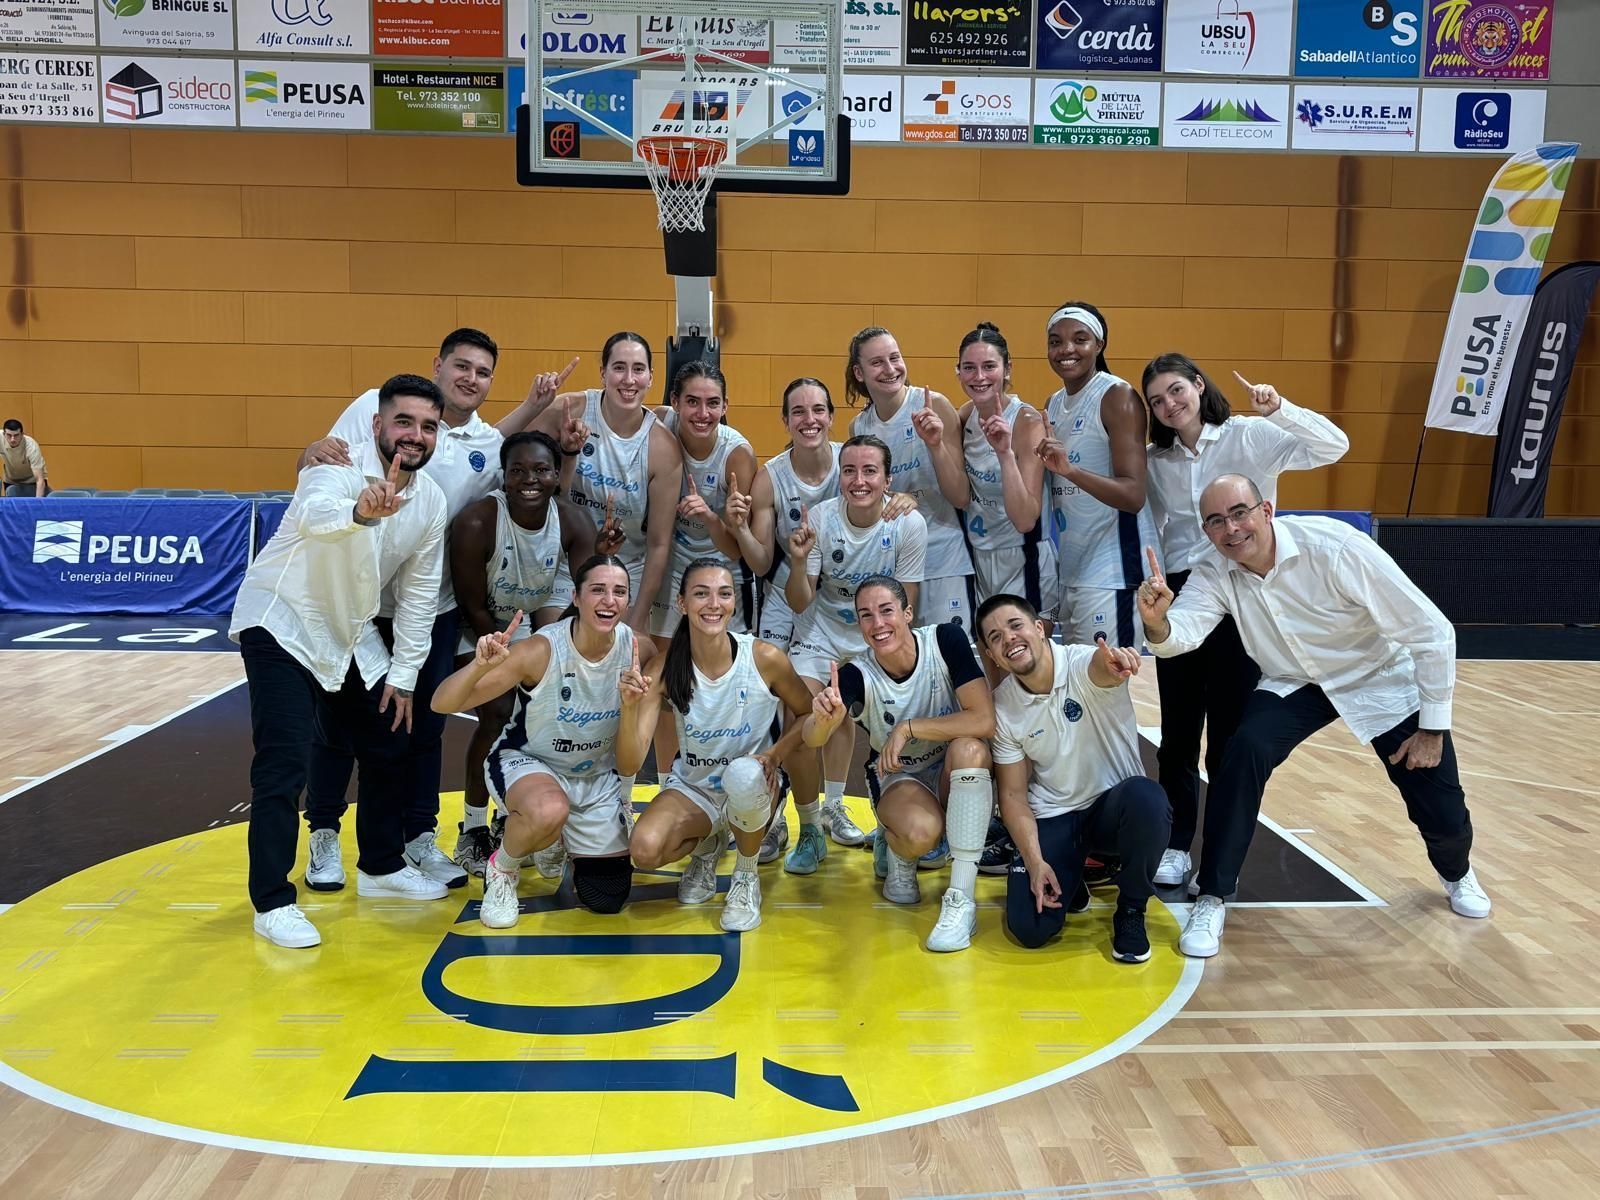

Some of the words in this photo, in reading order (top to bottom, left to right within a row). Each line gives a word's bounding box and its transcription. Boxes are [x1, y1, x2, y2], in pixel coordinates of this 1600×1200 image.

[152, 0, 209, 12] BRINGUE
[213, 1, 228, 12] SL
[873, 2, 900, 15] S.L.
[1202, 25, 1246, 39] UBSU
[1372, 7, 1384, 22] B
[1390, 12, 1417, 46] S
[256, 32, 282, 47] Alfa
[287, 33, 333, 46] Consult
[379, 36, 450, 45] www.kibuc.com
[521, 32, 626, 54] OLOM
[930, 32, 953, 43] 625
[957, 33, 980, 44] 492
[985, 33, 1008, 45] 926
[1078, 23, 1155, 51] cerdà
[737, 40, 766, 48] d'Urgell
[911, 47, 1027, 56] www.llavorsjardineria.com
[1300, 50, 1416, 64] SabadellAtlantico
[35, 59, 94, 77] CERESE
[21, 81, 32, 89] de
[36, 82, 48, 90] La
[51, 82, 77, 91] Salle,
[383, 74, 409, 84] Hotel
[417, 75, 471, 85] Restaurant
[474, 76, 497, 86] NICE
[168, 76, 231, 100] sideco
[283, 83, 365, 105] PEUSA
[30, 93, 70, 103] d'Urgell
[397, 91, 416, 100] Tel.
[420, 92, 438, 101] 973
[441, 92, 459, 101] 352
[463, 93, 481, 102] 100
[961, 94, 1012, 109] GDOS
[1102, 92, 1141, 102] MÚTUA
[22, 104, 43, 115] 973
[48, 105, 68, 116] 353
[73, 106, 94, 116] 816
[266, 109, 302, 118] L'energia
[318, 110, 345, 118] Pirineu
[1117, 103, 1141, 111] L'ALT
[1324, 105, 1412, 119] S.U.R.E.M
[905, 130, 957, 140] www.gdos.cat
[961, 128, 975, 139] Tel.
[977, 129, 992, 140] 973
[995, 129, 1010, 140] 350
[1012, 129, 1028, 140] 075
[1043, 127, 1149, 135] www.mutuacomarcal.com
[1181, 127, 1210, 137] CADÍ
[1213, 129, 1273, 138] TELECOM
[1464, 129, 1504, 138] RàdioSeu
[1042, 134, 1065, 143] Tel.
[1071, 135, 1093, 144] 973
[1100, 136, 1122, 144] 360
[1128, 136, 1151, 145] 290
[1499, 320, 1512, 356] benestar
[1495, 355, 1504, 370] teu
[1491, 370, 1498, 381] el
[1487, 382, 1496, 399] mou
[1482, 401, 1491, 415] Ens
[1511, 321, 1567, 485] taurus
[88, 536, 203, 564] PEUSA
[61, 571, 111, 584] L'energia
[115, 572, 131, 582] del
[135, 572, 173, 582] Pirineu
